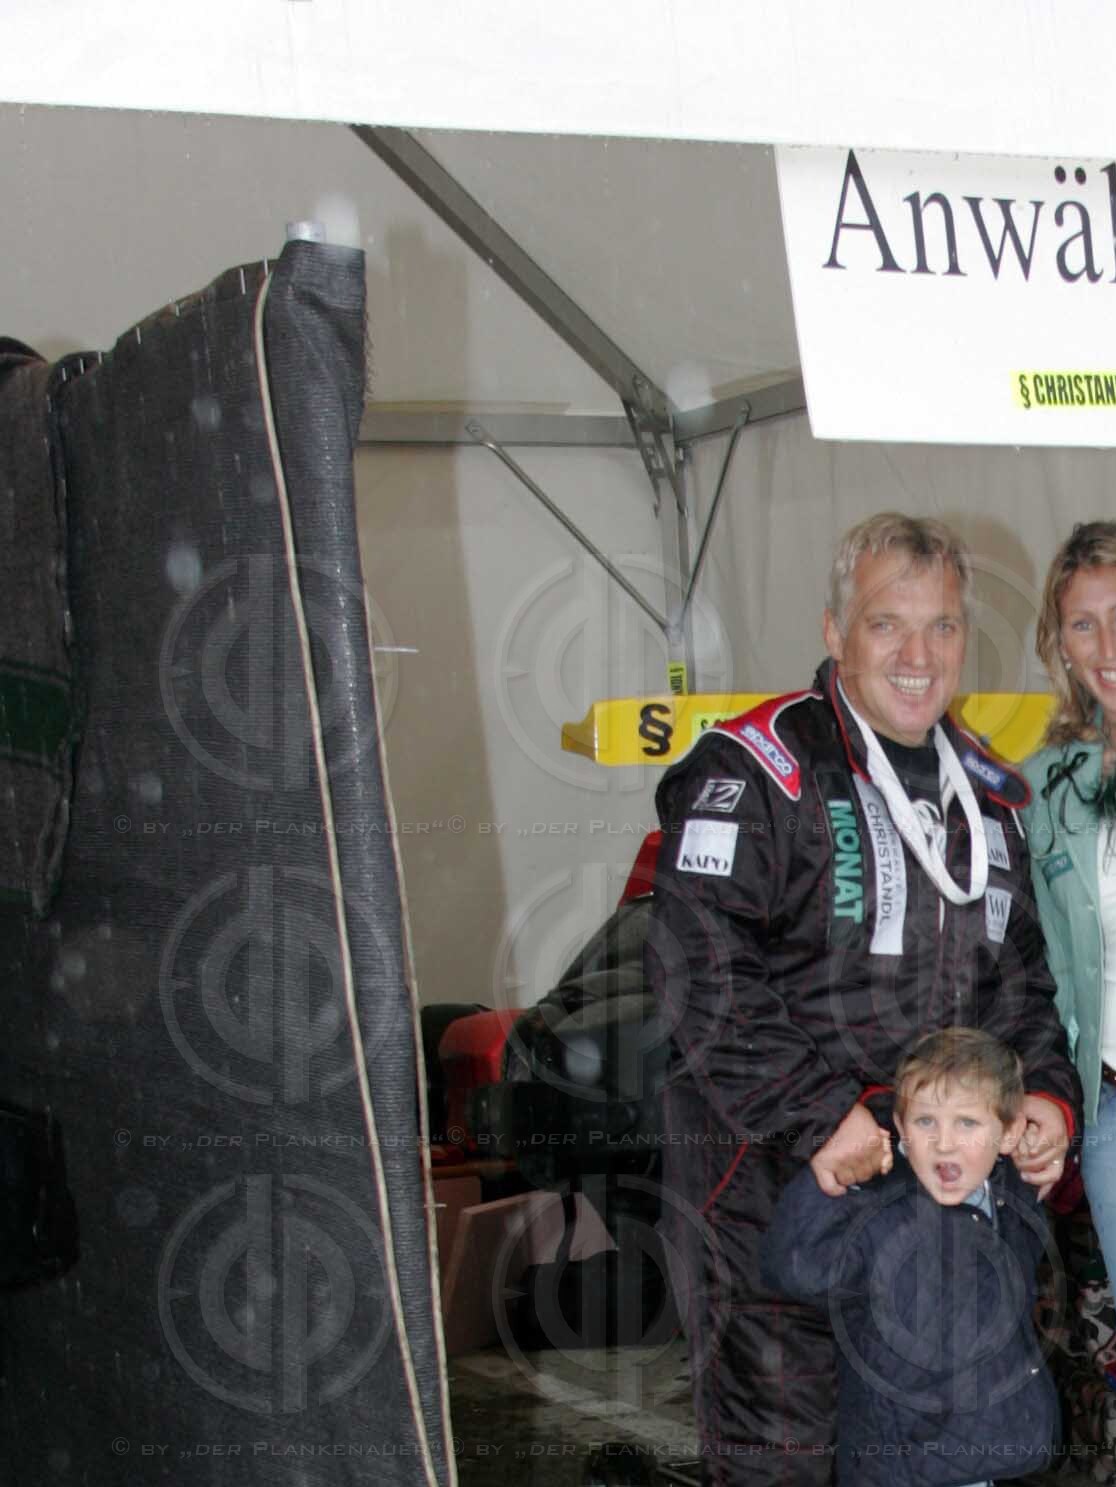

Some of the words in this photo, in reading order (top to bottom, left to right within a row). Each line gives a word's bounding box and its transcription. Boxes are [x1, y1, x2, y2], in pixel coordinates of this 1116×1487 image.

[1017, 373, 1031, 409] §
[639, 703, 673, 757] §
[827, 799, 864, 924] MONAT
[866, 801, 893, 926] CHRISTANDL
